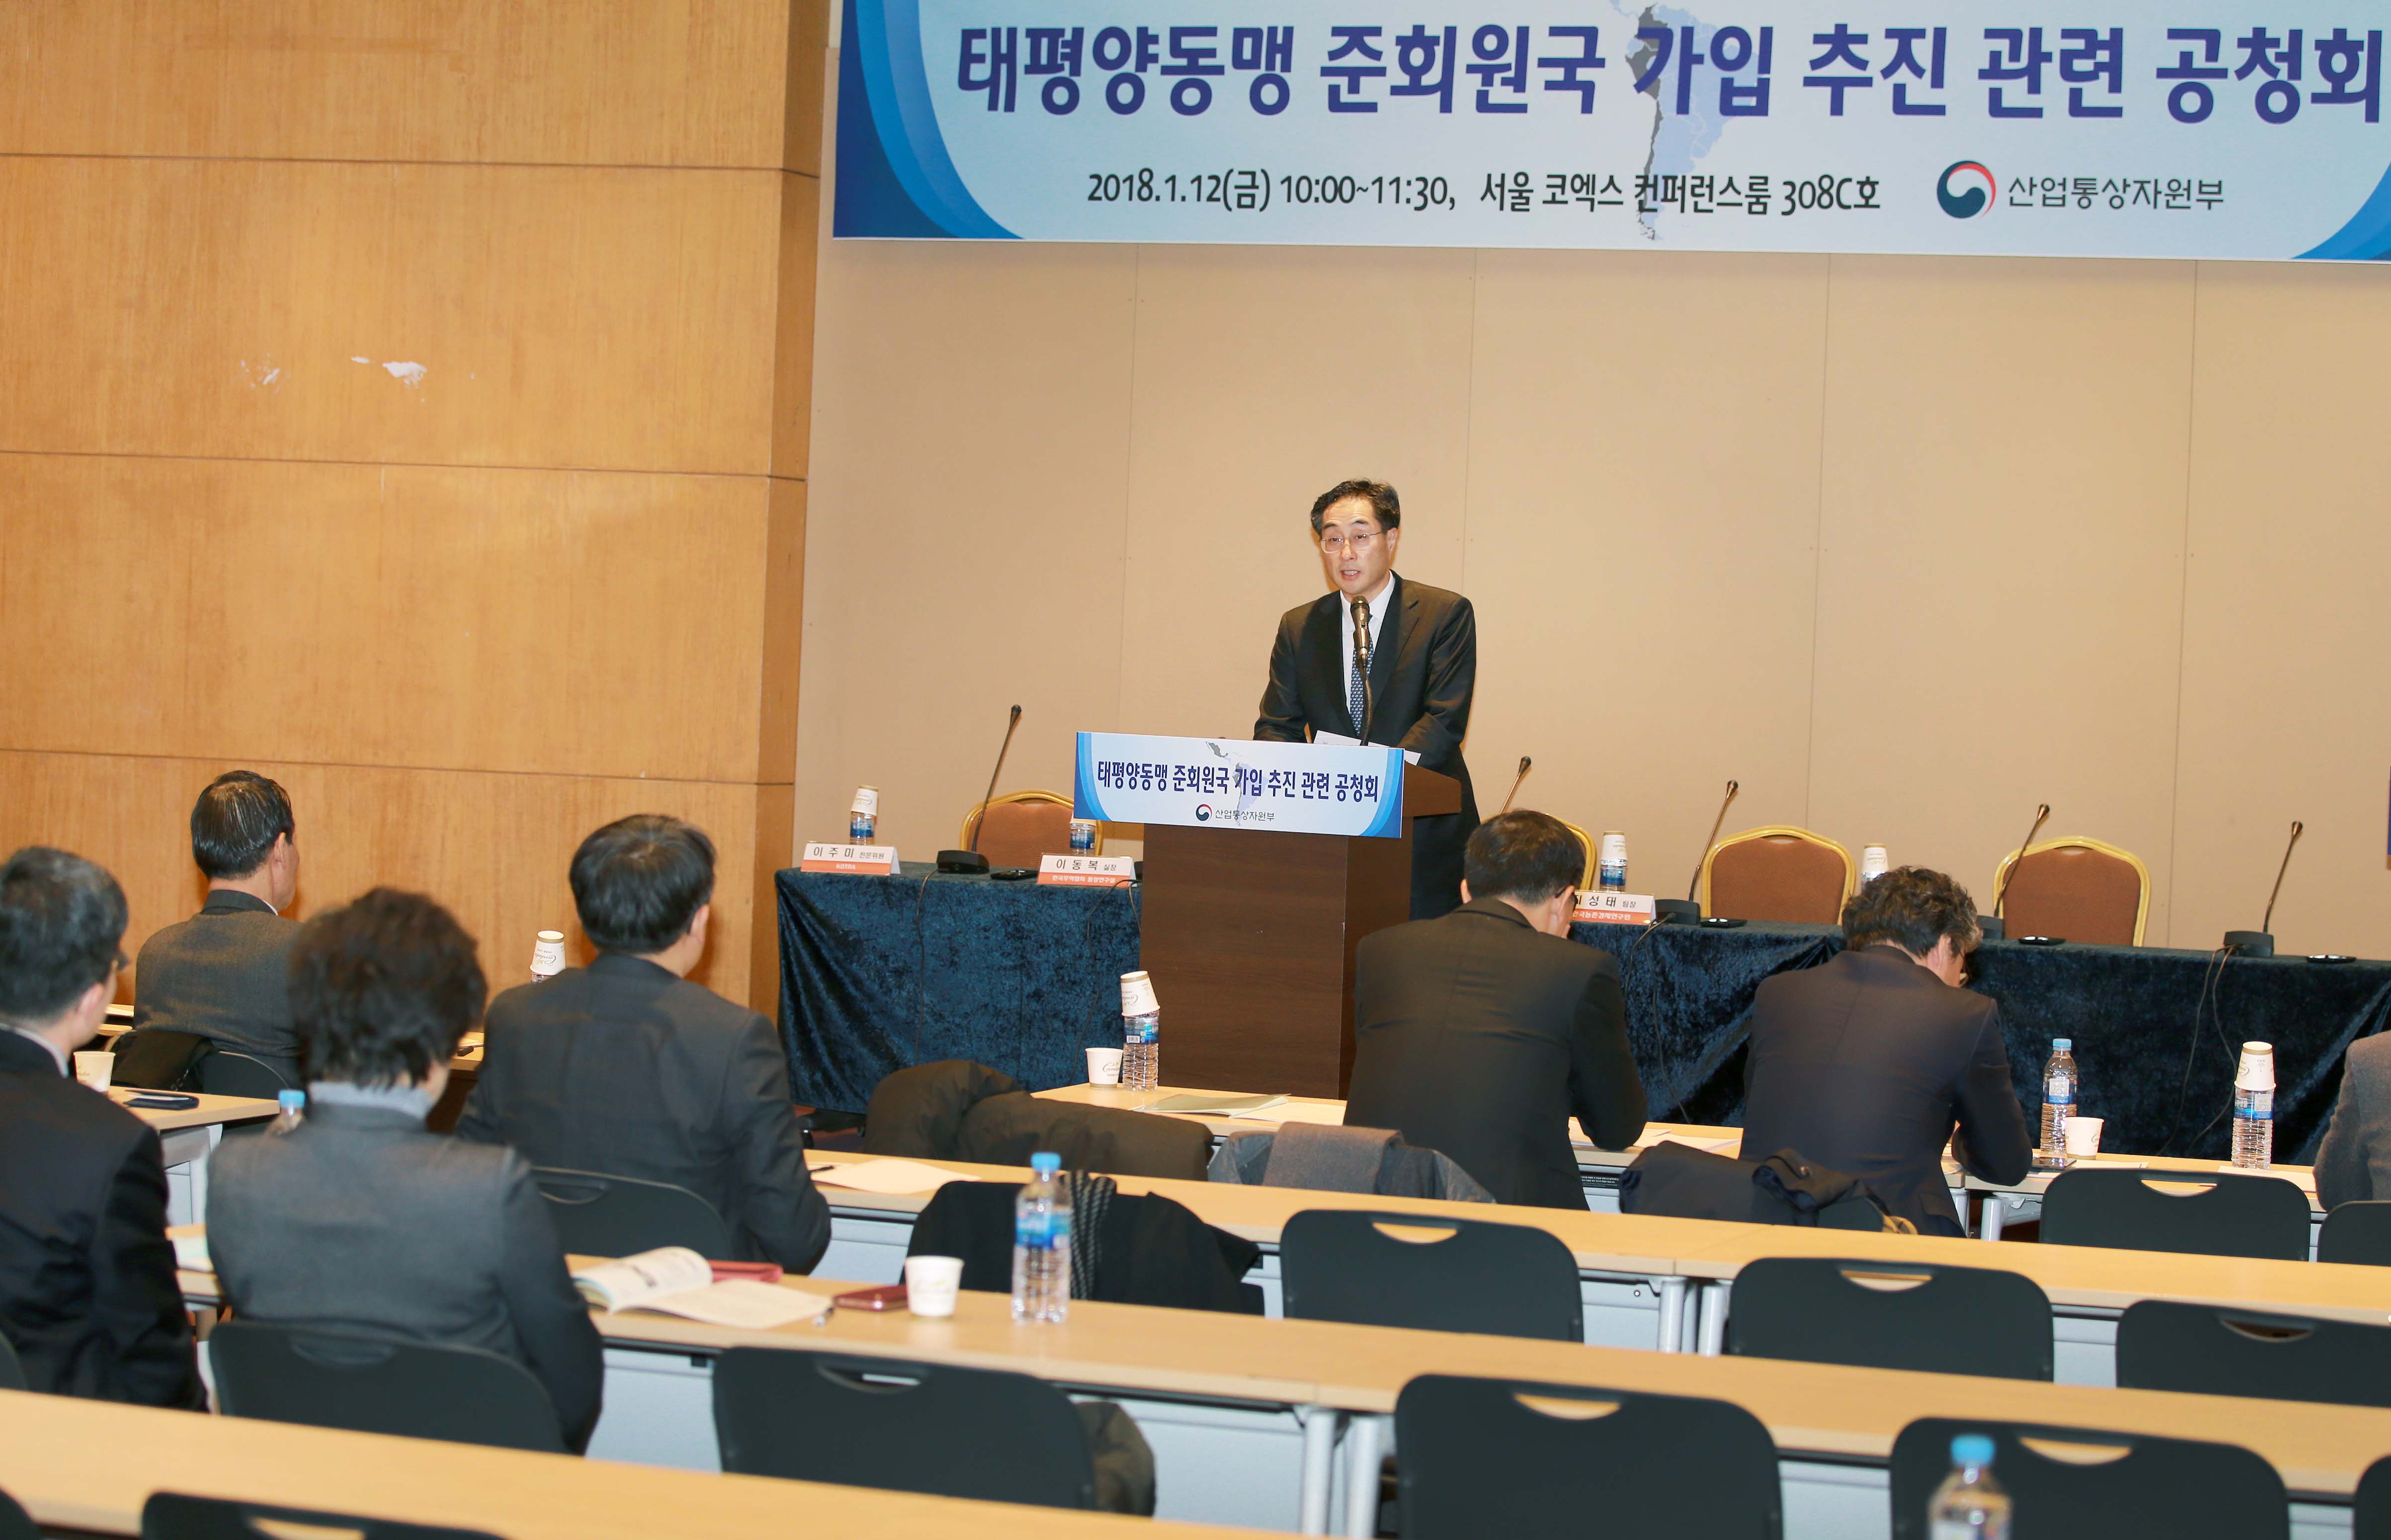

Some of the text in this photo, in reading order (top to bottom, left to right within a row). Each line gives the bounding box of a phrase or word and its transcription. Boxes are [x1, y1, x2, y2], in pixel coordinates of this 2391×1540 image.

[958, 24, 2383, 124] 태평양동맹 준회원국 가입 추진 관련 공청회
[1088, 167, 1881, 216] 2018.1.12(금) 10:00~11:30, 서울 코엑스 컨퍼런스룸 308C호
[2008, 176, 2224, 211] 산업통상자원부
[1097, 761, 1378, 803] 태평양동맹 준회원국 가입 추진 관련 공청회
[1215, 809, 1275, 822] 산업통상자원부
